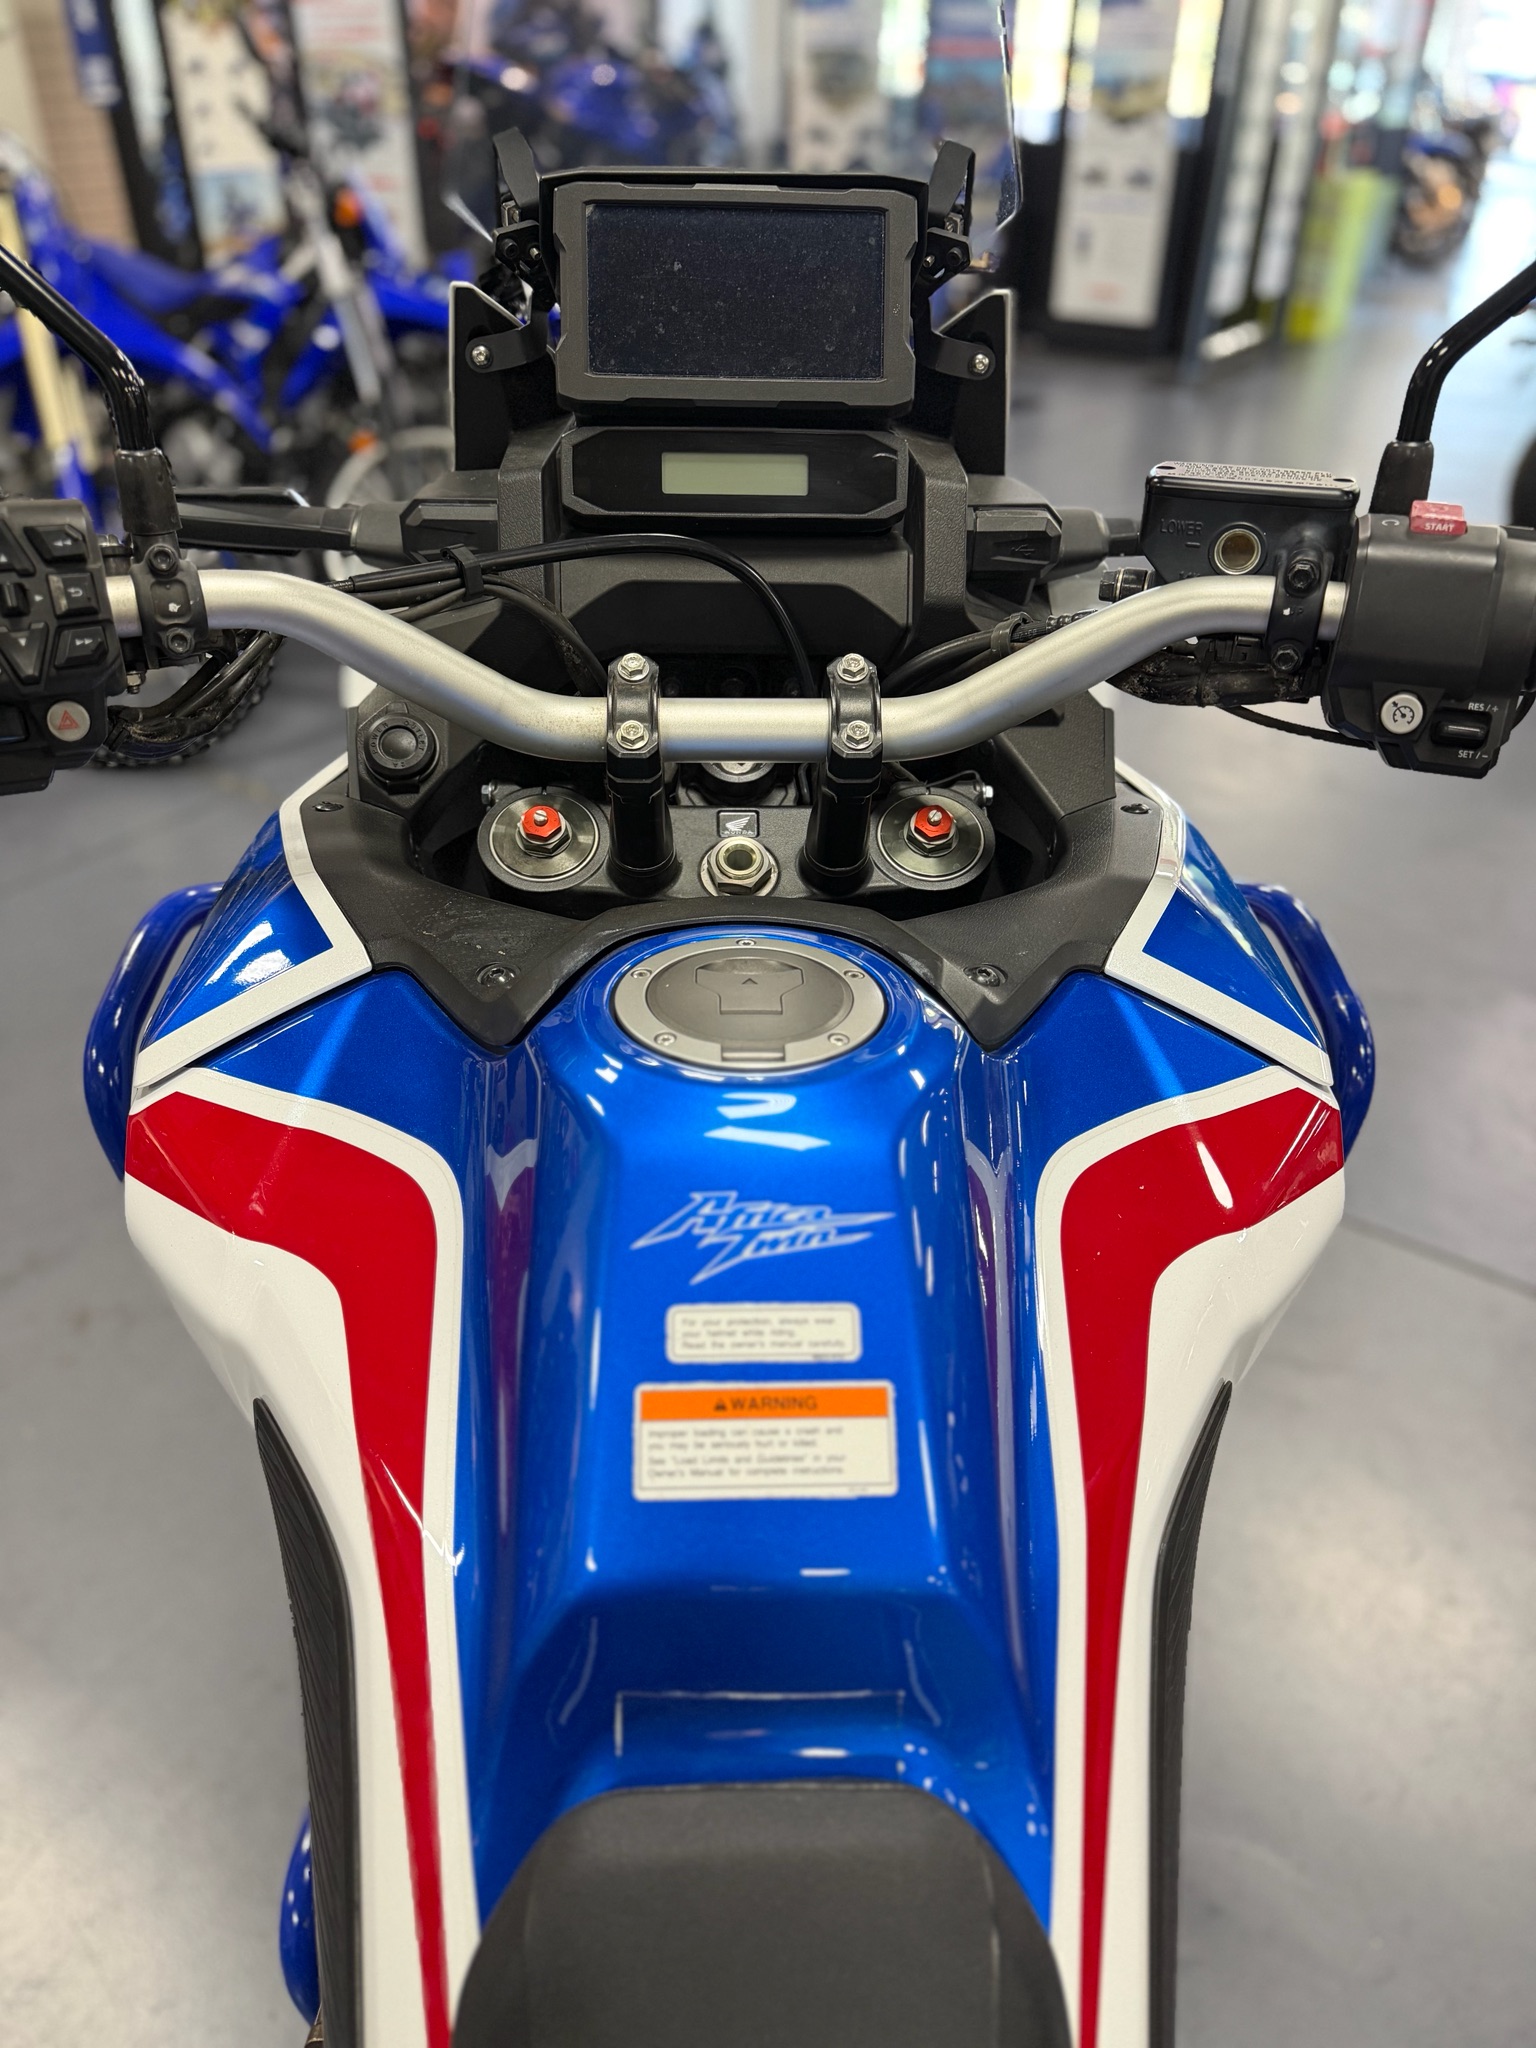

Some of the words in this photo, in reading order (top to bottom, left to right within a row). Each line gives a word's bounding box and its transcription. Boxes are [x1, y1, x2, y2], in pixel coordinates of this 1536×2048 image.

[1160, 518, 1204, 536] LOWER
[1424, 523, 1455, 532] START
[730, 1396, 818, 1412] WARNING
